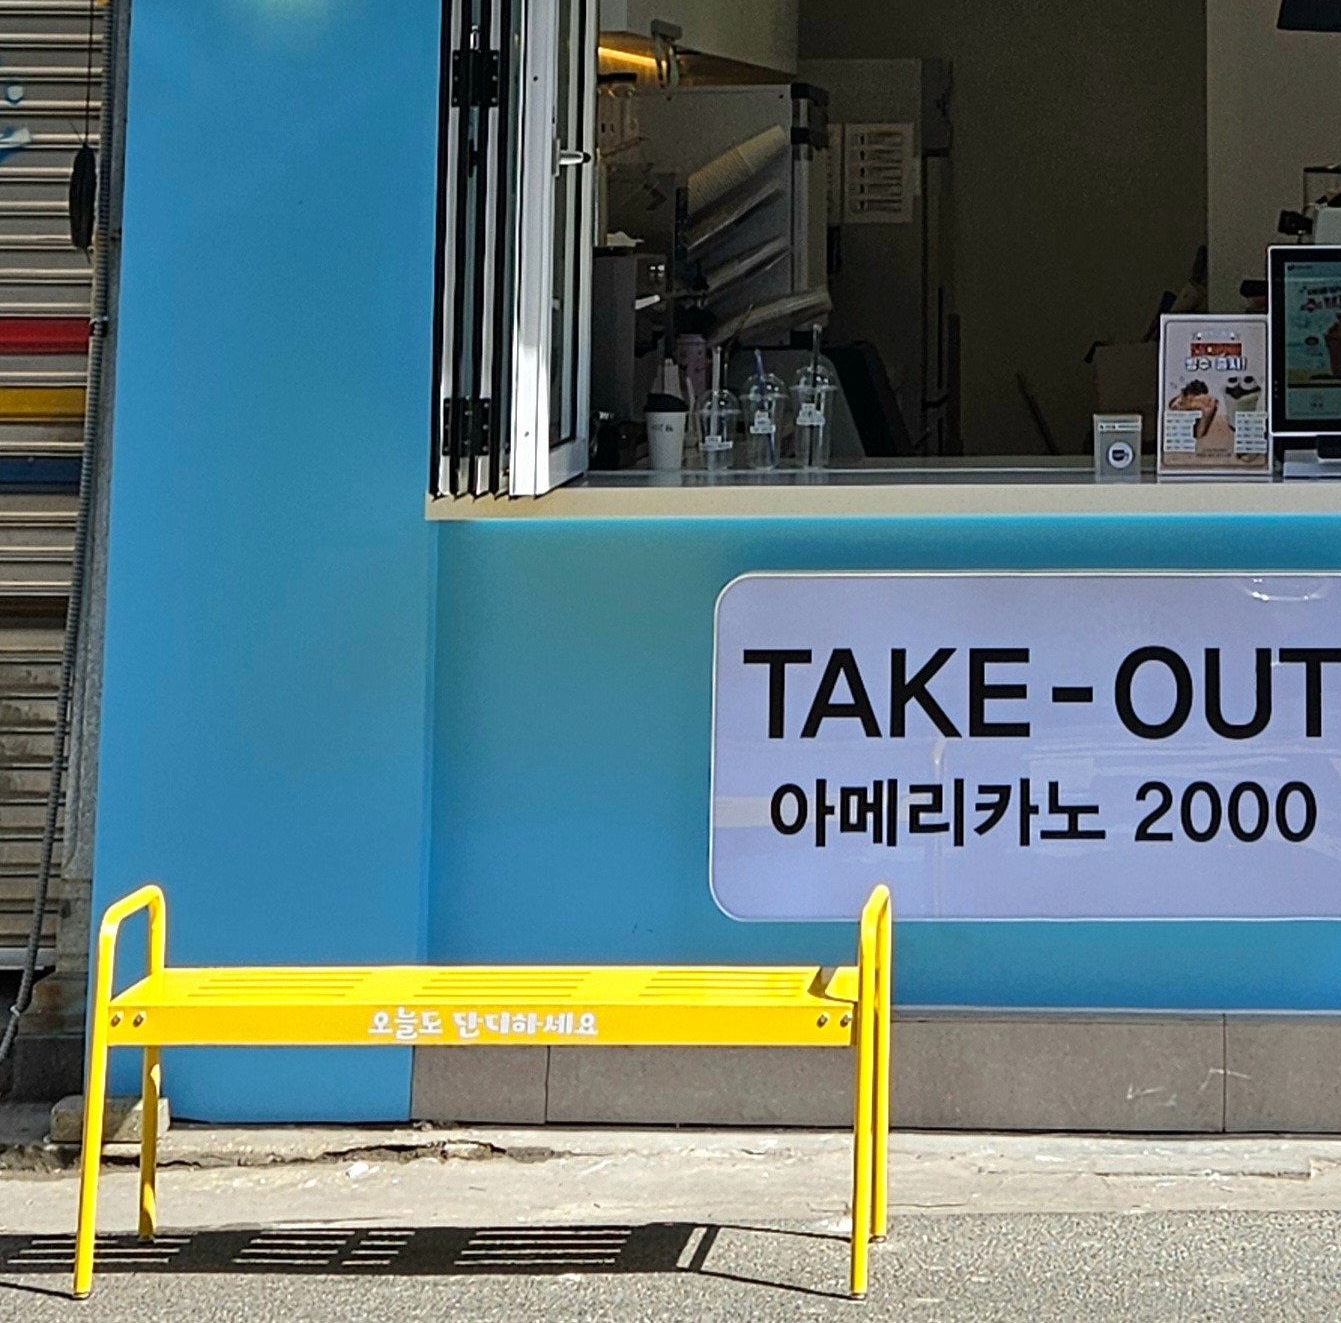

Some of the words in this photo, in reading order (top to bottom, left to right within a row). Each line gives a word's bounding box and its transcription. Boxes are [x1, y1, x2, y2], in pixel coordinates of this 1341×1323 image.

[770, 778, 1106, 848] 아메리카노
[1134, 780, 1318, 843] 2000
[367, 1006, 443, 1040] 오늘도
[453, 1011, 599, 1039] 단디하세요
